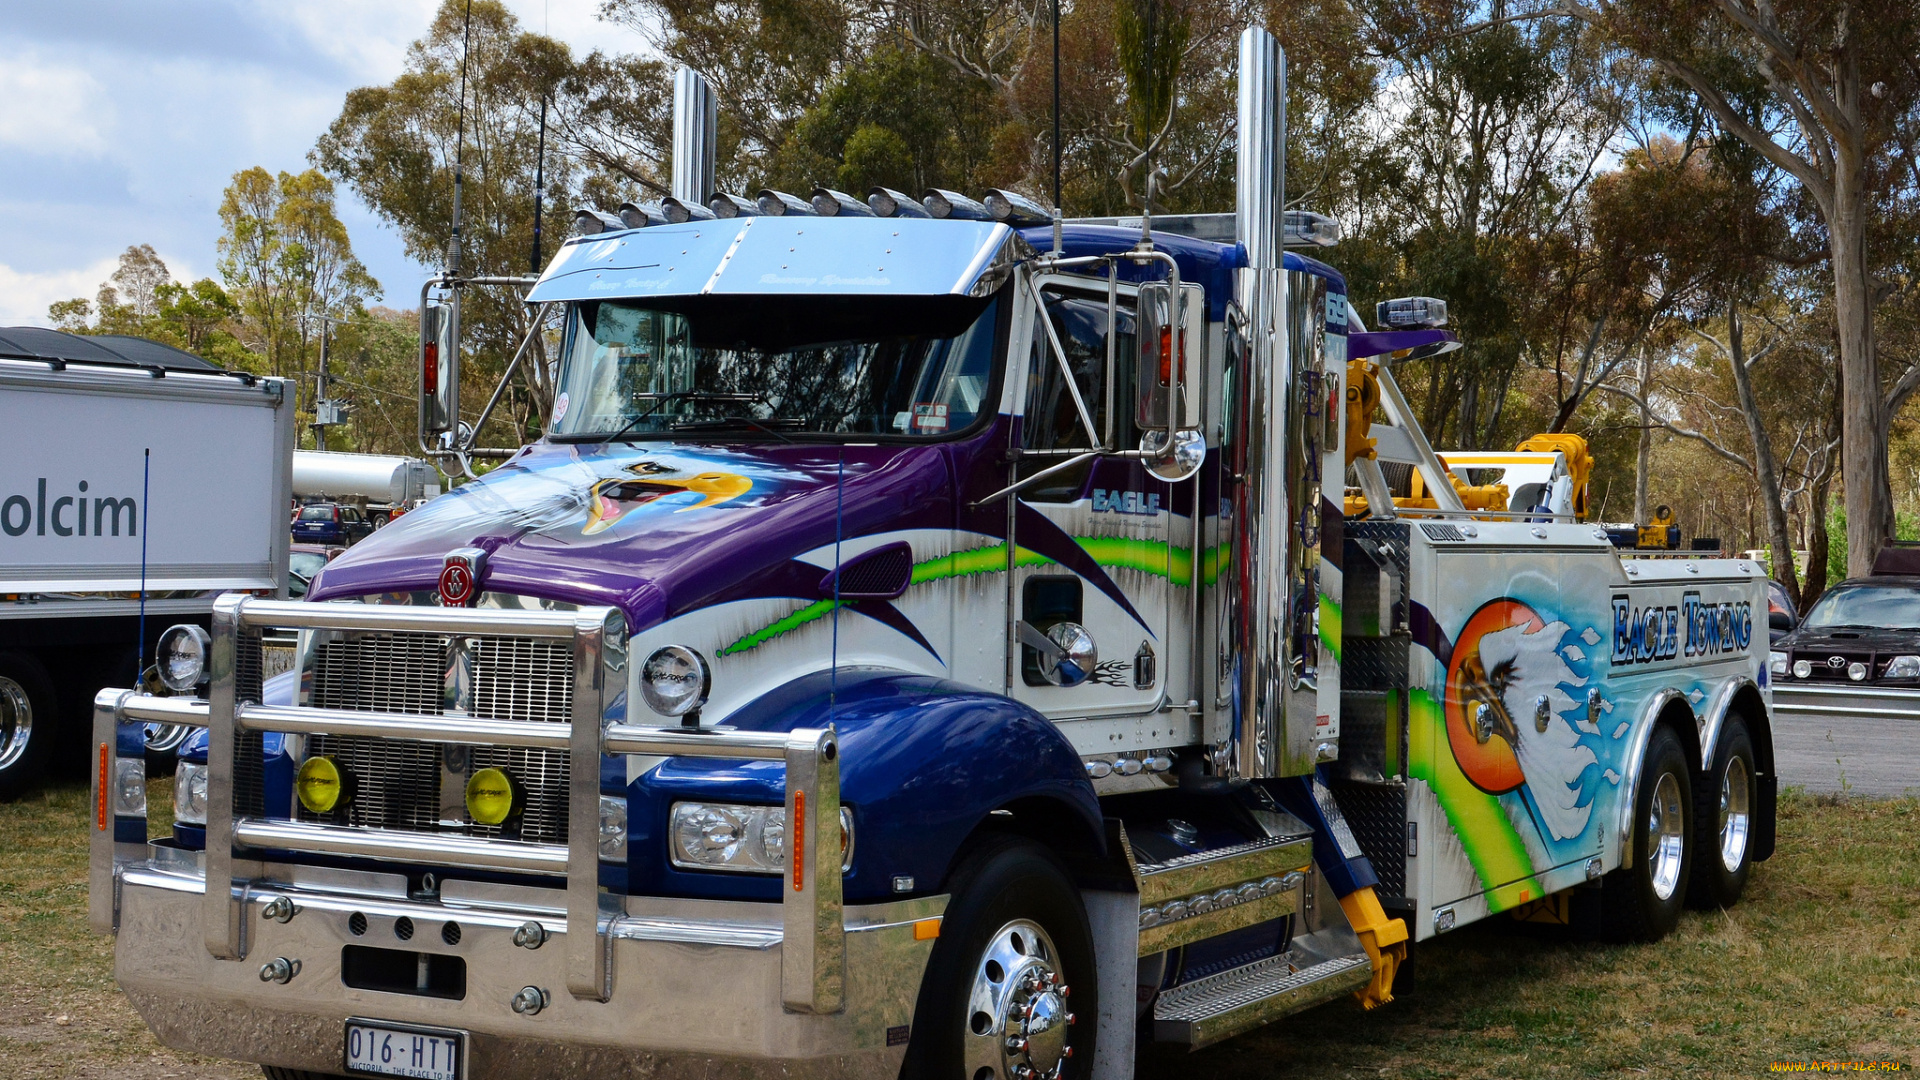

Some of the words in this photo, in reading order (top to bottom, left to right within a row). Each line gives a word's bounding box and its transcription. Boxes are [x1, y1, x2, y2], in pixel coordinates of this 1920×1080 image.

[1092, 488, 1160, 517] EAGLE
[350, 1061, 383, 1073] VICTORIA
[393, 1066, 405, 1077] THE
[409, 1069, 430, 1080] PLACE
